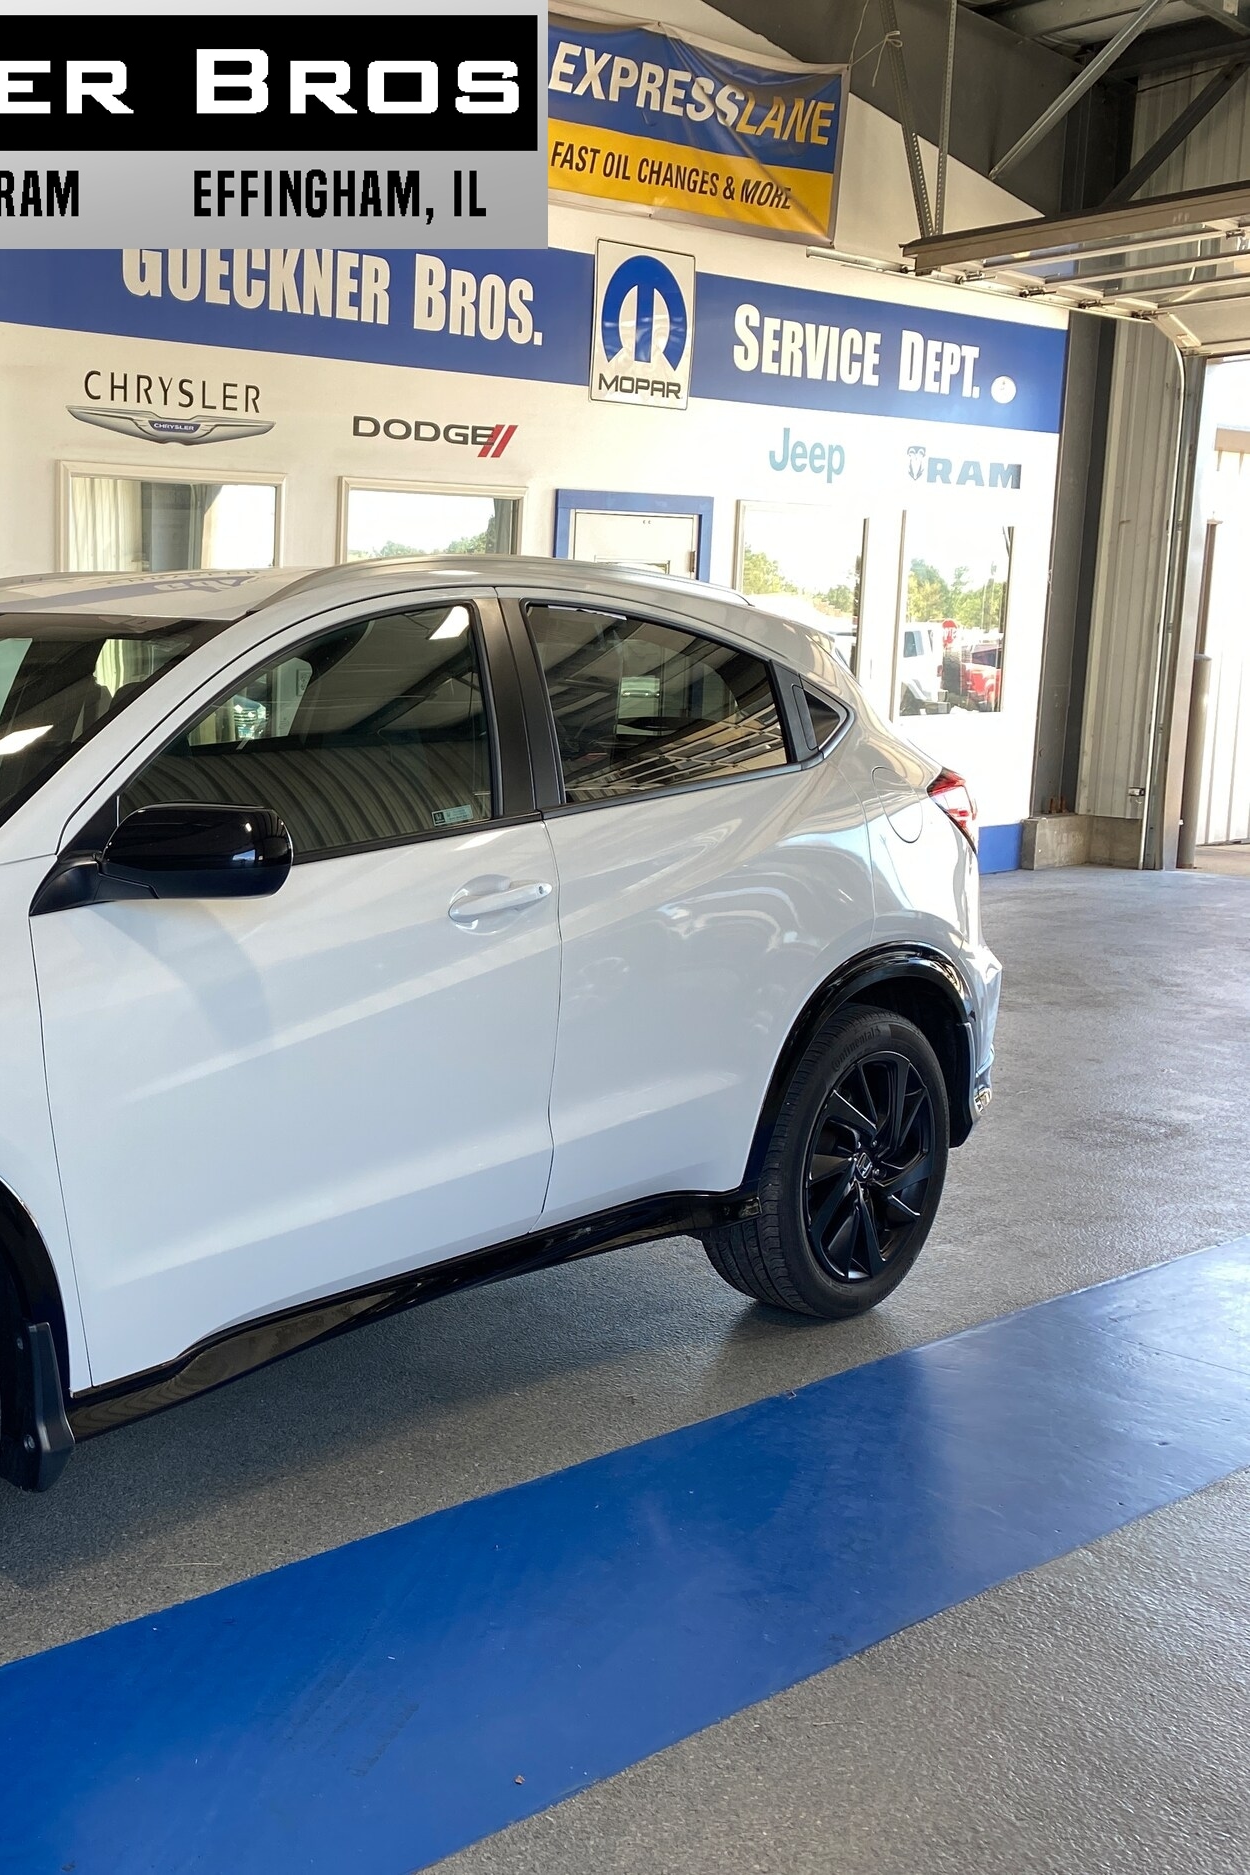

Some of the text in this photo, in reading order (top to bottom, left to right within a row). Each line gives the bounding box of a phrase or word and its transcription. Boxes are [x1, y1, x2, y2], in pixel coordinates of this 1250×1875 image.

[550, 140, 792, 210] FAST OIL CHANGES & MORE
[121, 248, 544, 347] GOECKNER BROS.
[732, 303, 981, 400] SERVICE DEPT.
[83, 369, 262, 414] CHRYSLER
[597, 372, 683, 401] MOPAR
[152, 421, 195, 433] CHRYSLER
[352, 414, 496, 446] DODGE
[768, 426, 845, 484] Jeep
[925, 461, 1023, 491] RAM
